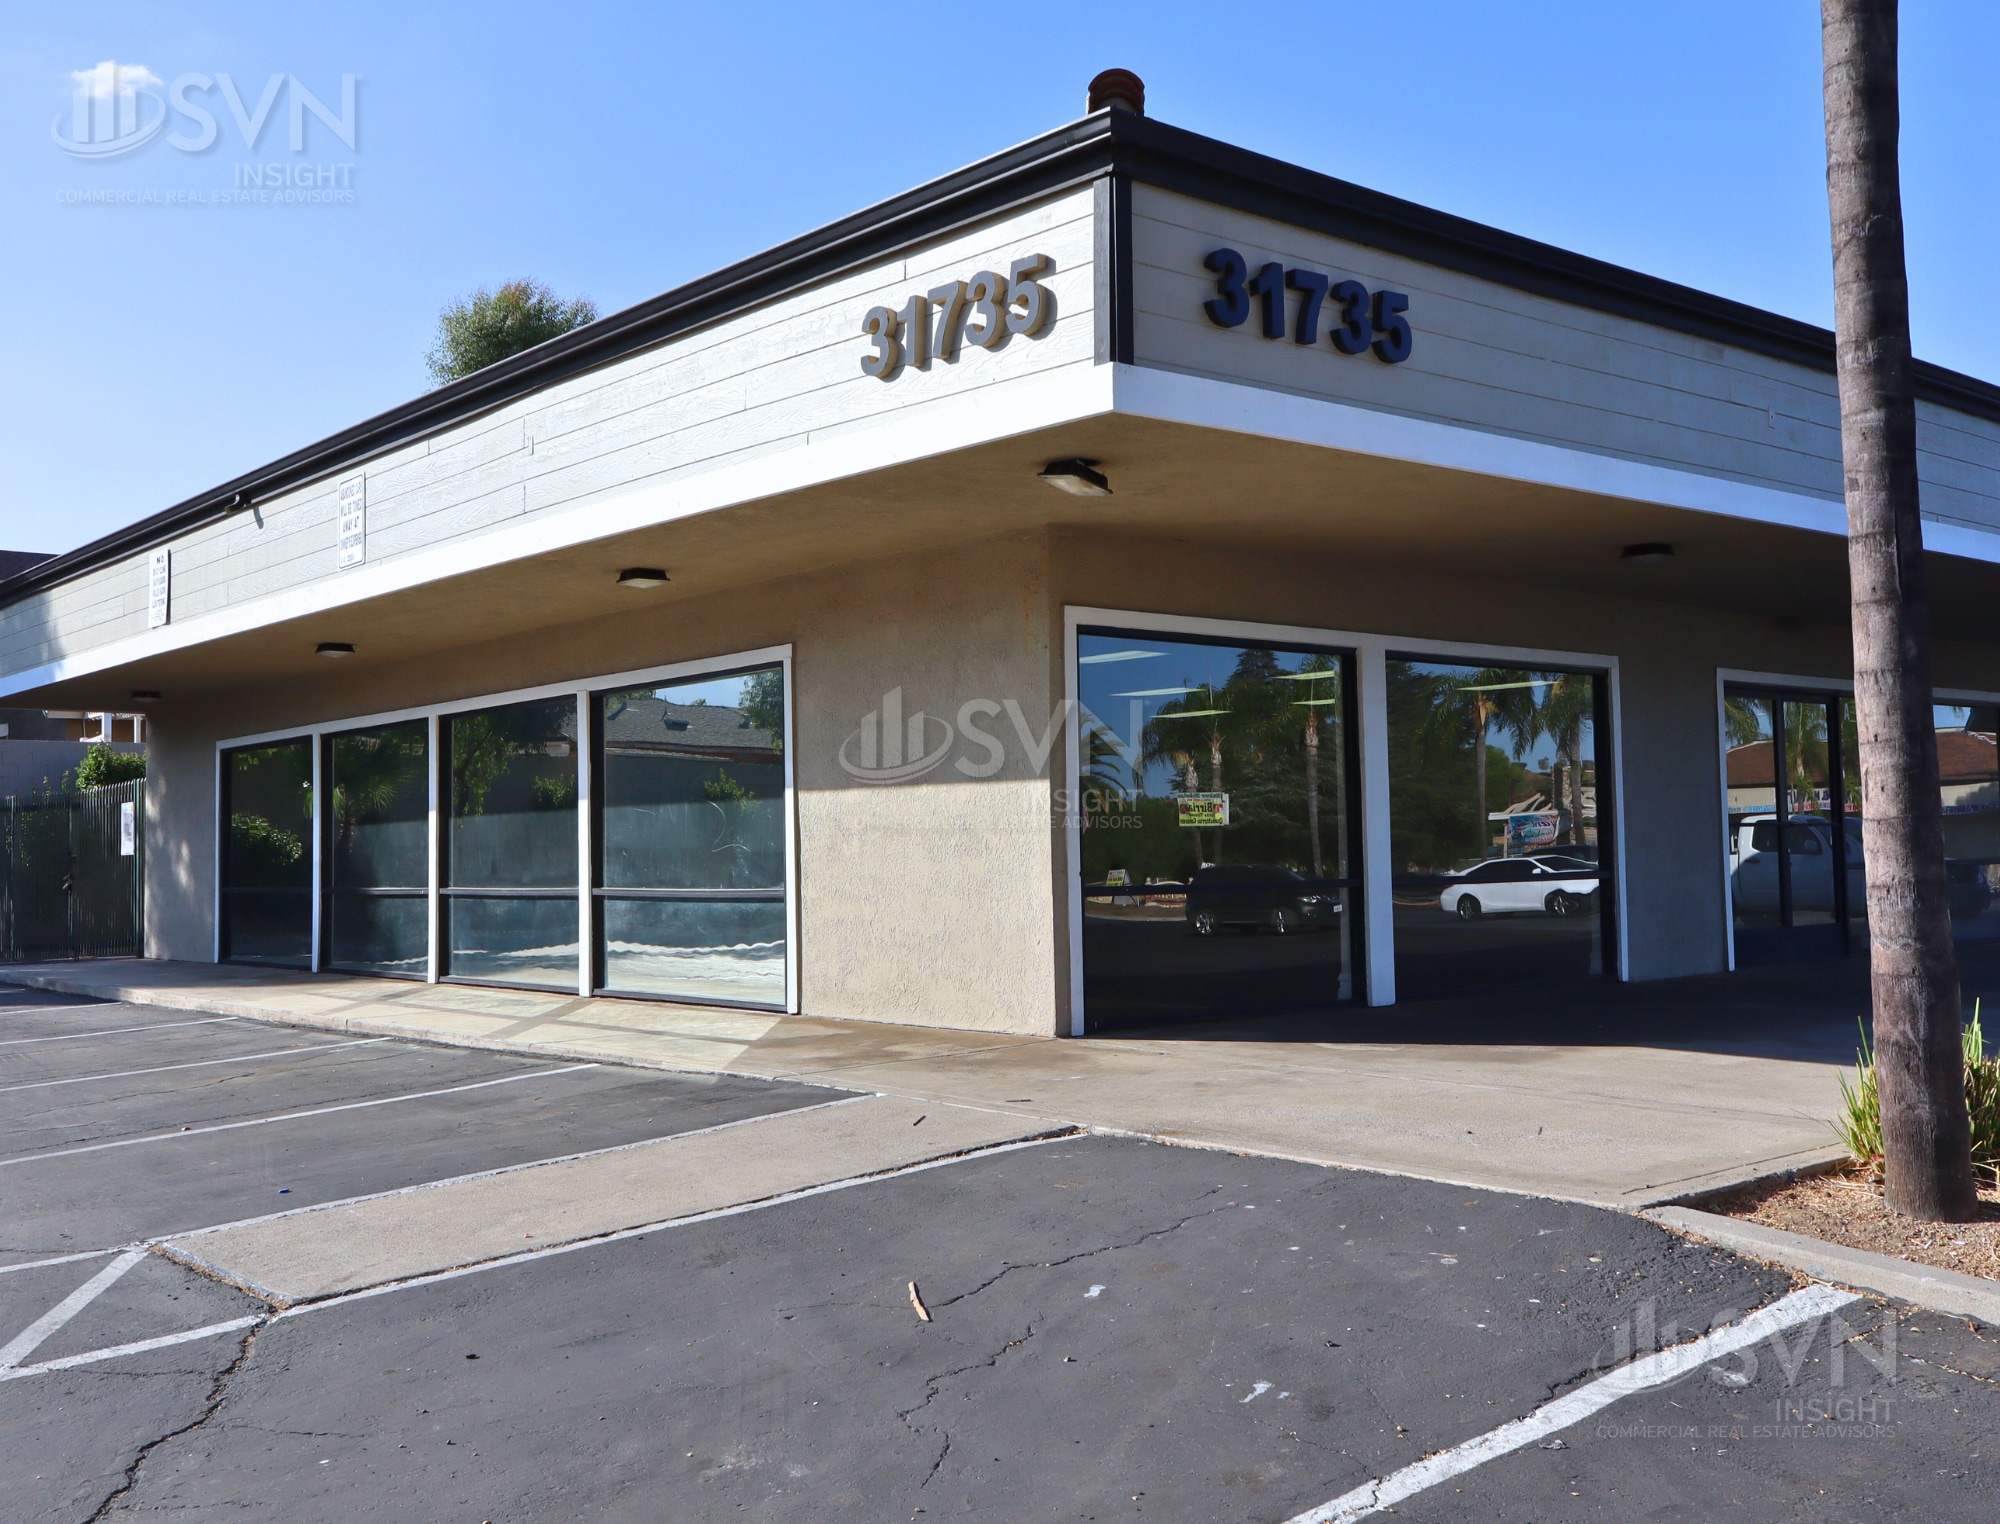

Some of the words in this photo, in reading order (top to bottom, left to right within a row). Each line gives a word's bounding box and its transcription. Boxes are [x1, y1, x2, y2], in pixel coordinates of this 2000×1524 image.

[861, 252, 1050, 380] 31735
[1203, 247, 1413, 364] 31735
[157, 554, 164, 565] NO
